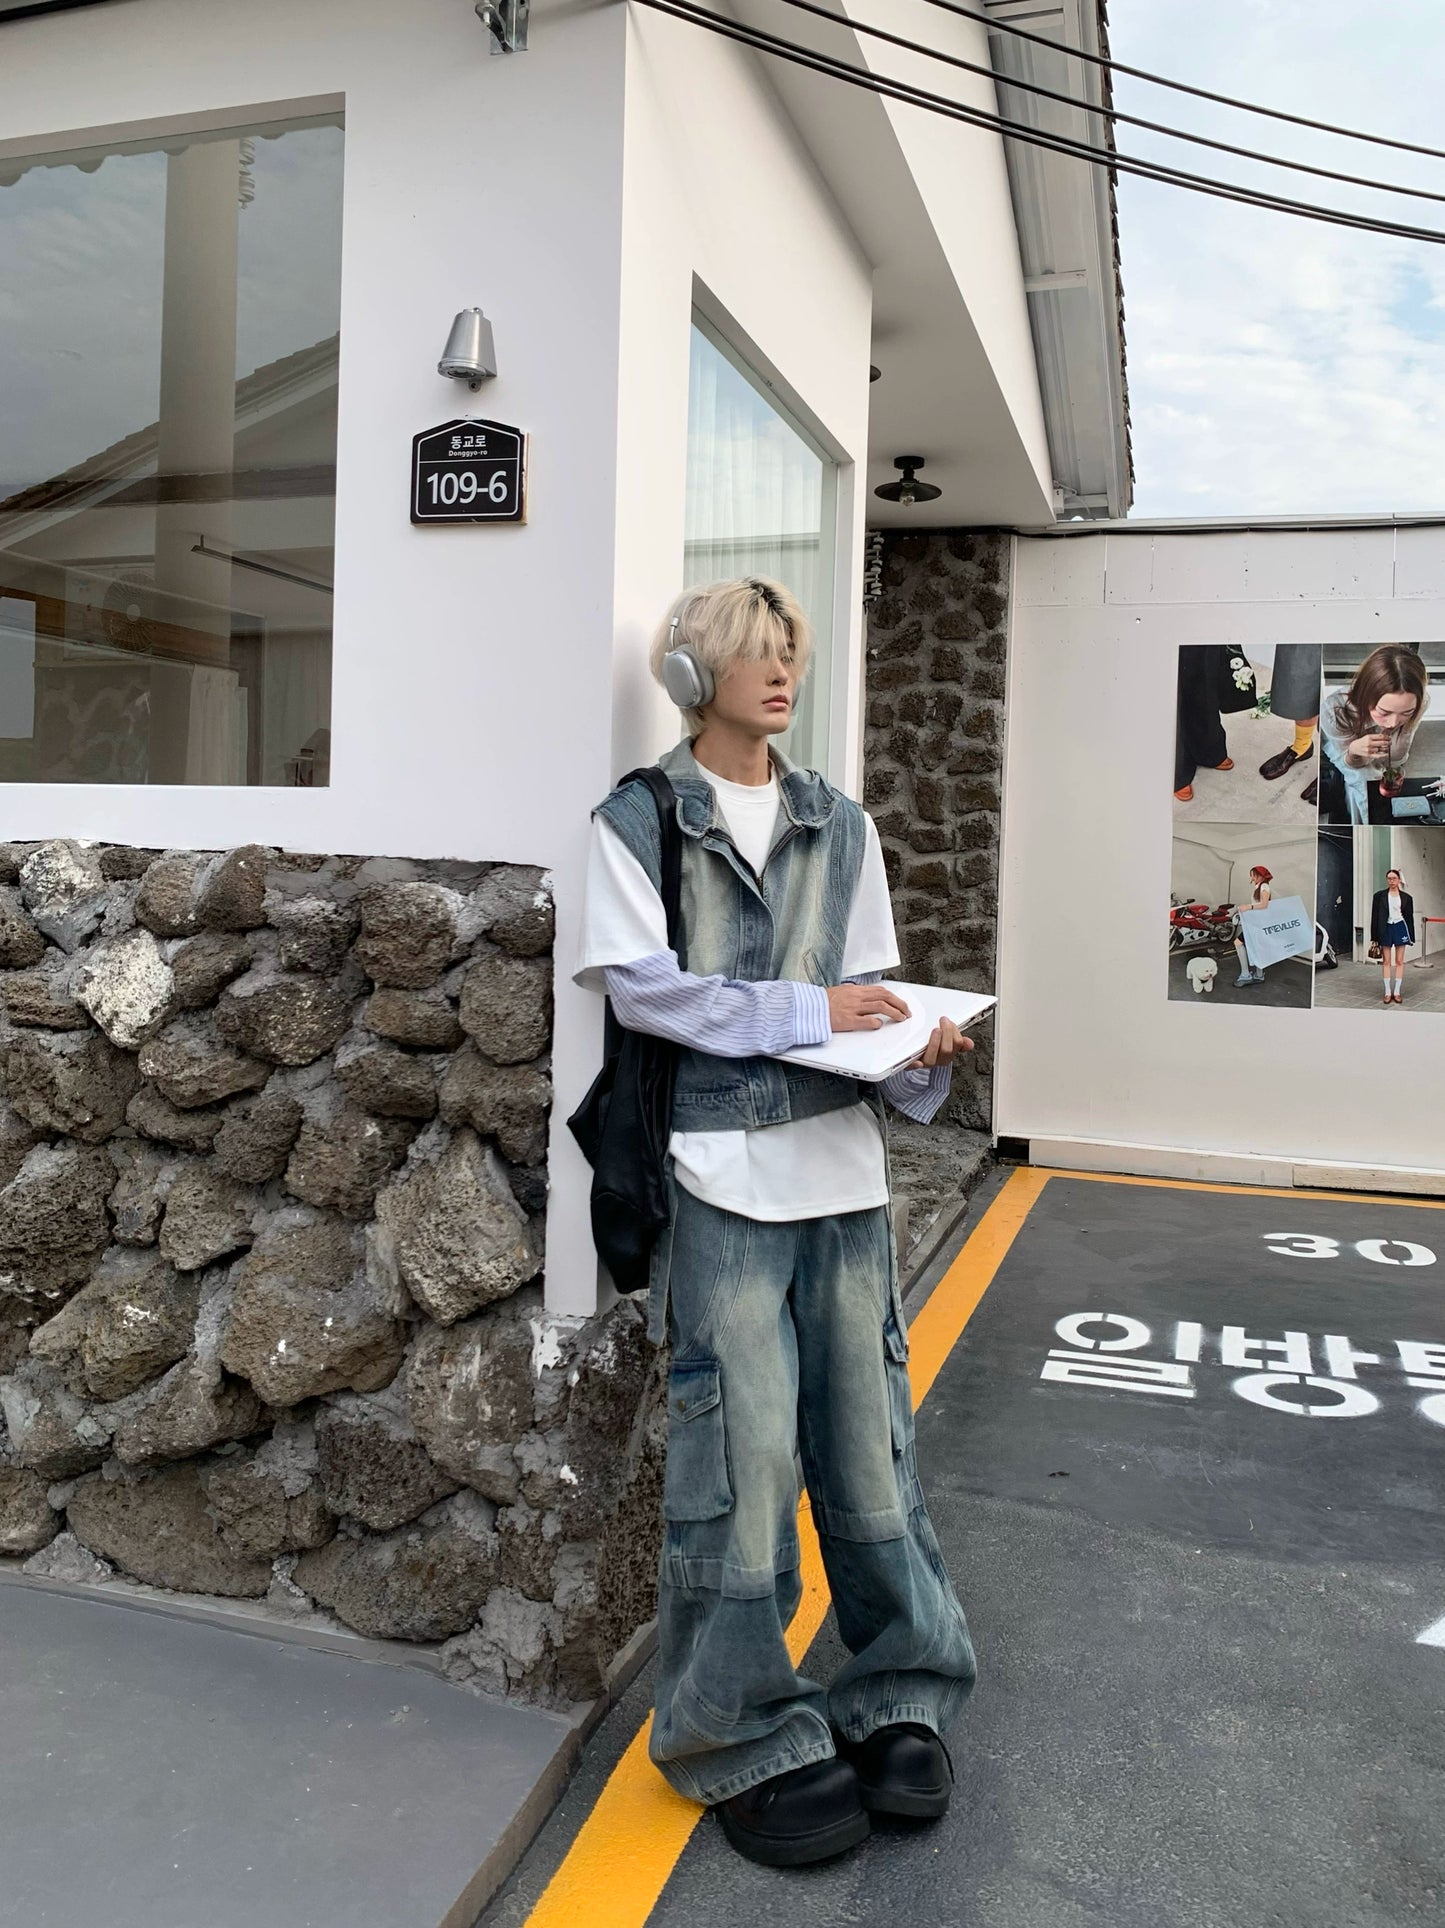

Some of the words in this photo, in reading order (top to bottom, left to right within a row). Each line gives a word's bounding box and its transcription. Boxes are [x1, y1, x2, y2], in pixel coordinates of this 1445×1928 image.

[450, 435, 487, 450] 동교로
[427, 470, 508, 505] 109-6
[1261, 1232, 1437, 1266] 30
